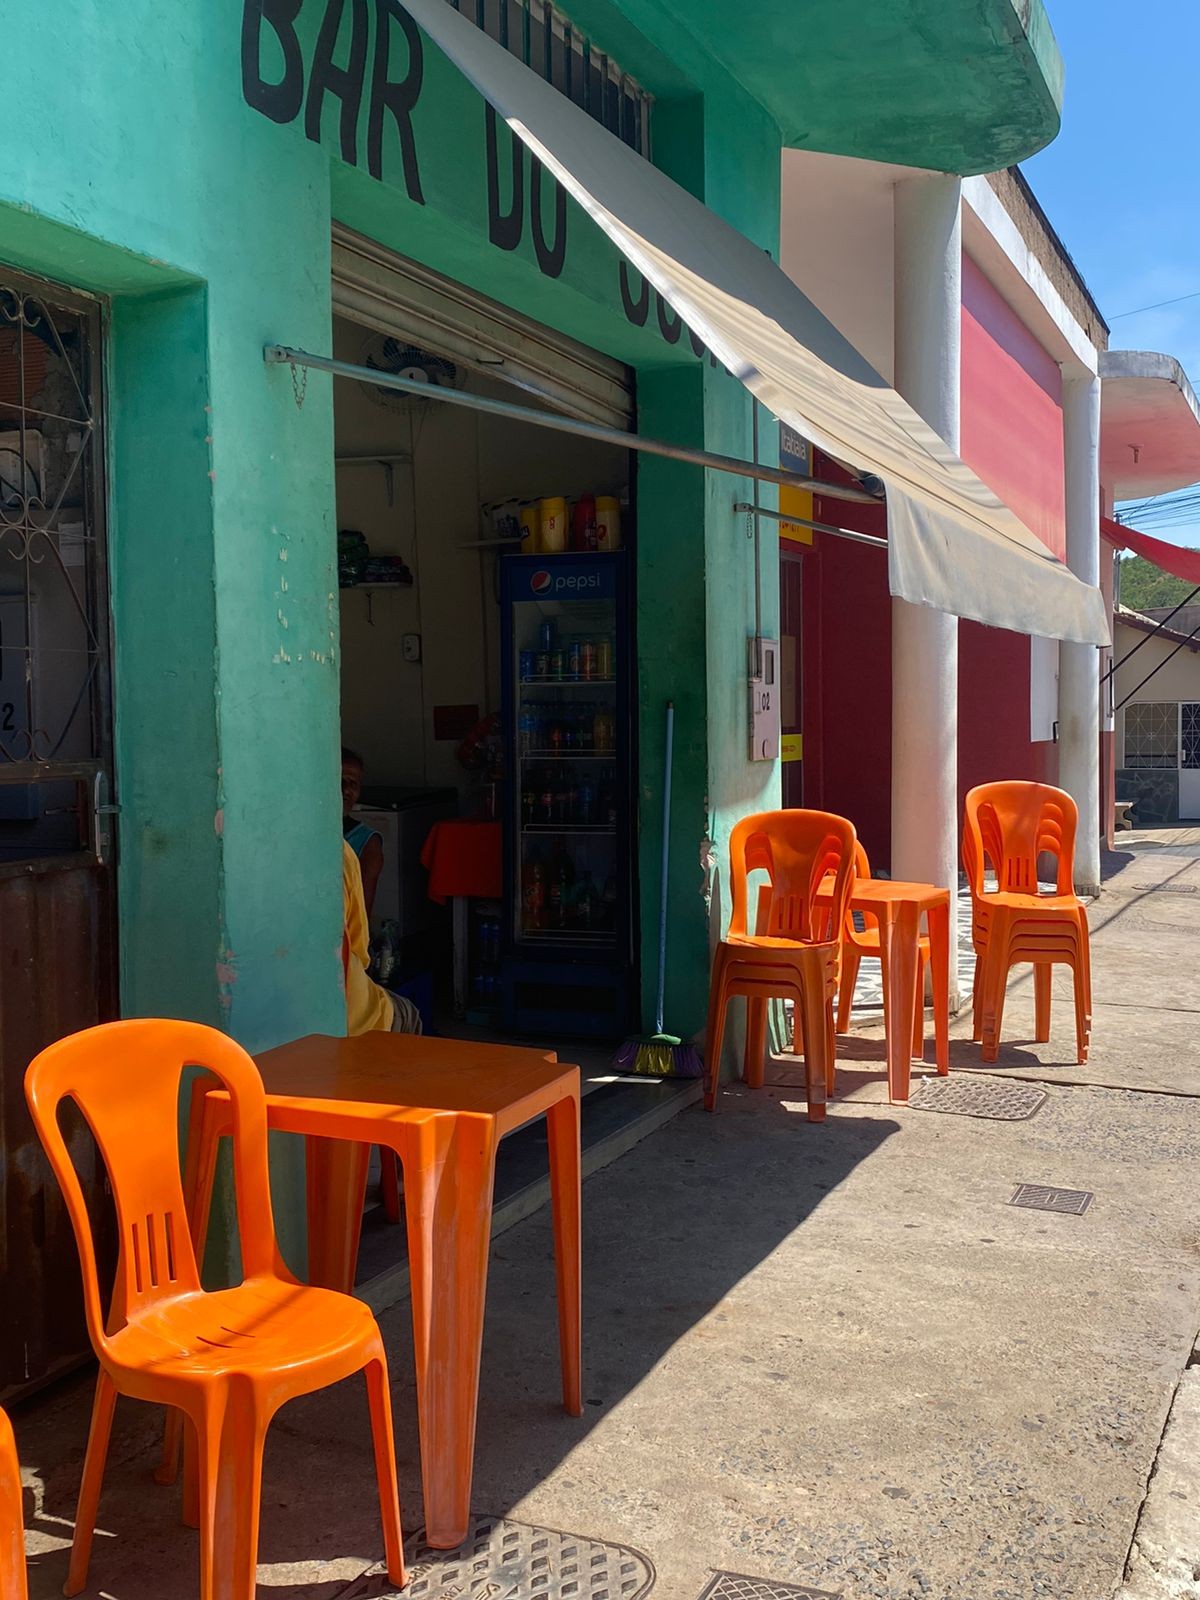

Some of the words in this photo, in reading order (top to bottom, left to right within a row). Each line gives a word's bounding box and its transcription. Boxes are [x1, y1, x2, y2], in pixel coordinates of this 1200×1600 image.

[241, 0, 425, 206] BAR
[555, 573, 600, 592] pepsi
[761, 692, 770, 711] 02
